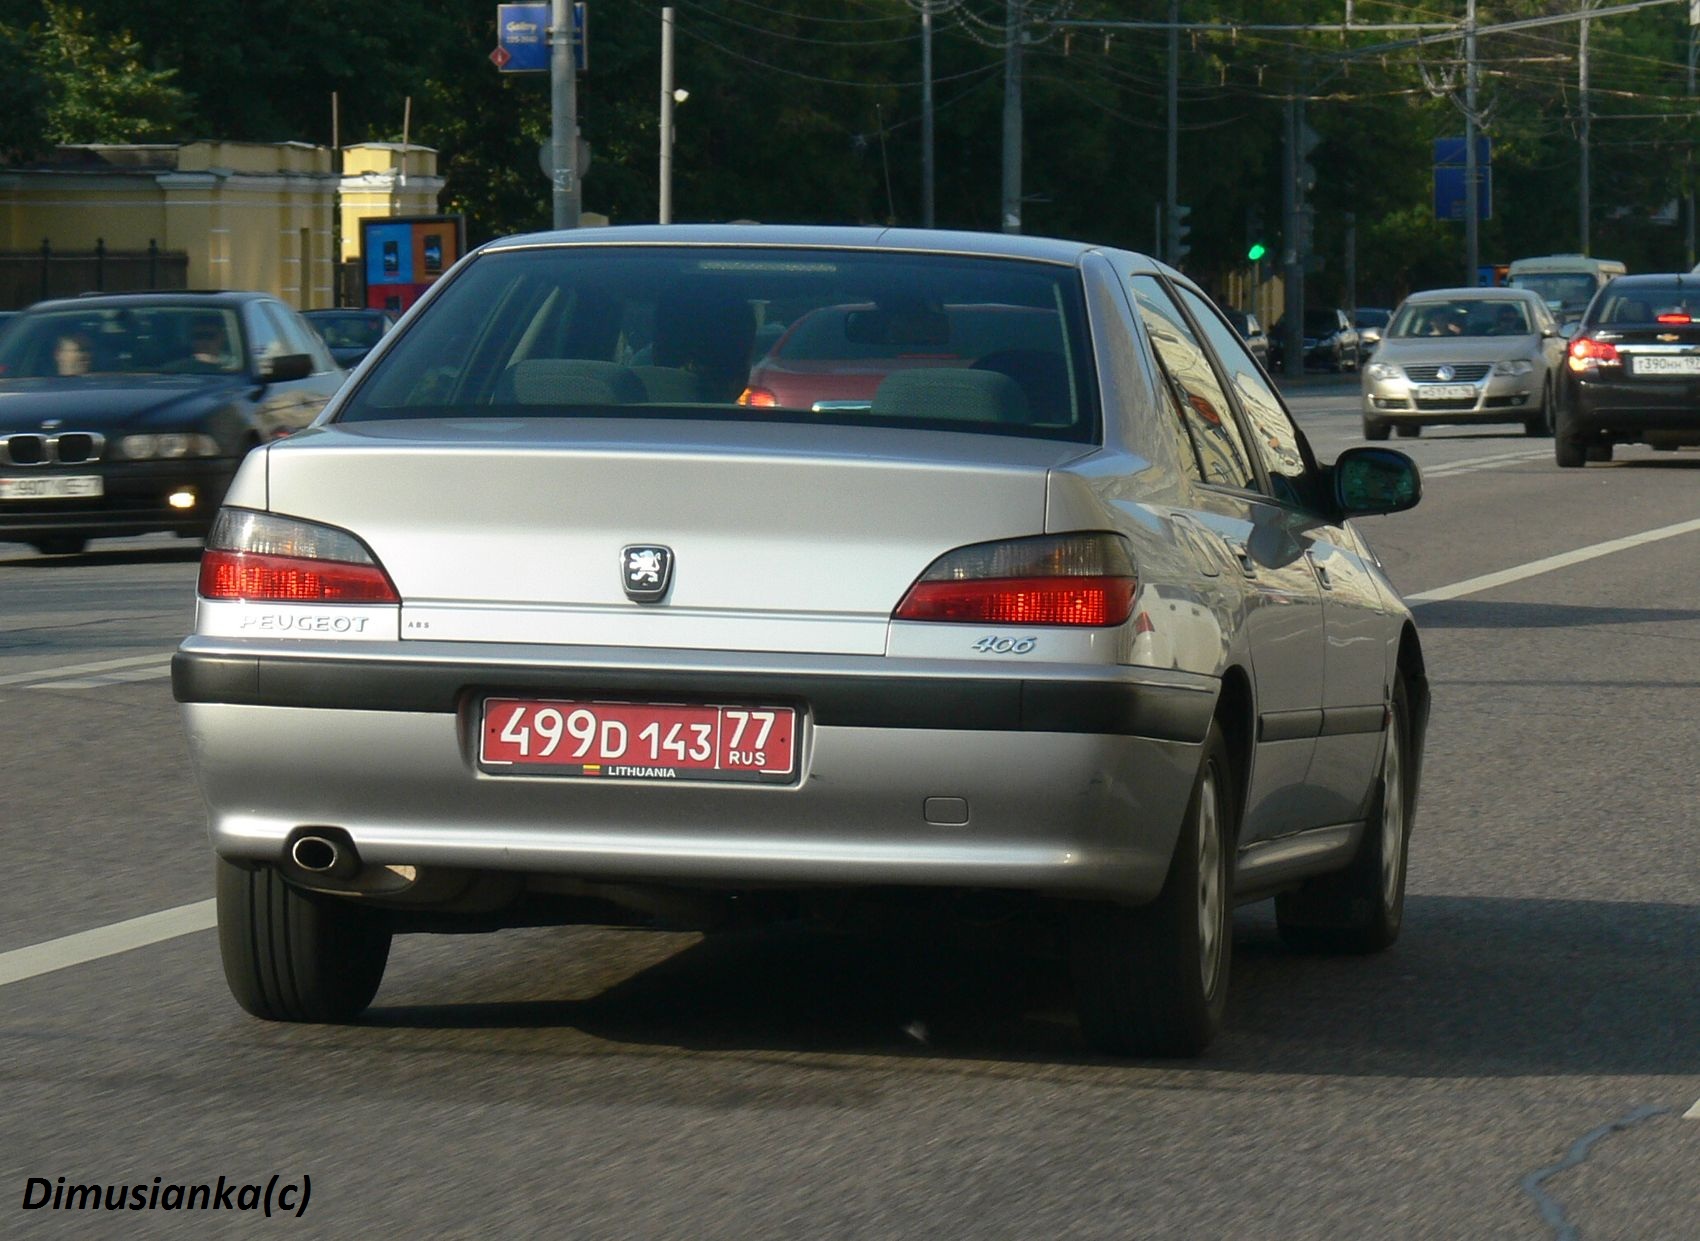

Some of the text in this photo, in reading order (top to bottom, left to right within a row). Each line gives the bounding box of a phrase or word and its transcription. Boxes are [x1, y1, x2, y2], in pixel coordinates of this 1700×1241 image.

[240, 615, 370, 633] PEUGEOT
[970, 635, 1038, 655] 406
[500, 706, 713, 761] 499D 143
[725, 711, 776, 750] 77
[728, 751, 766, 766] RUS
[608, 765, 676, 778] LITHUANIA
